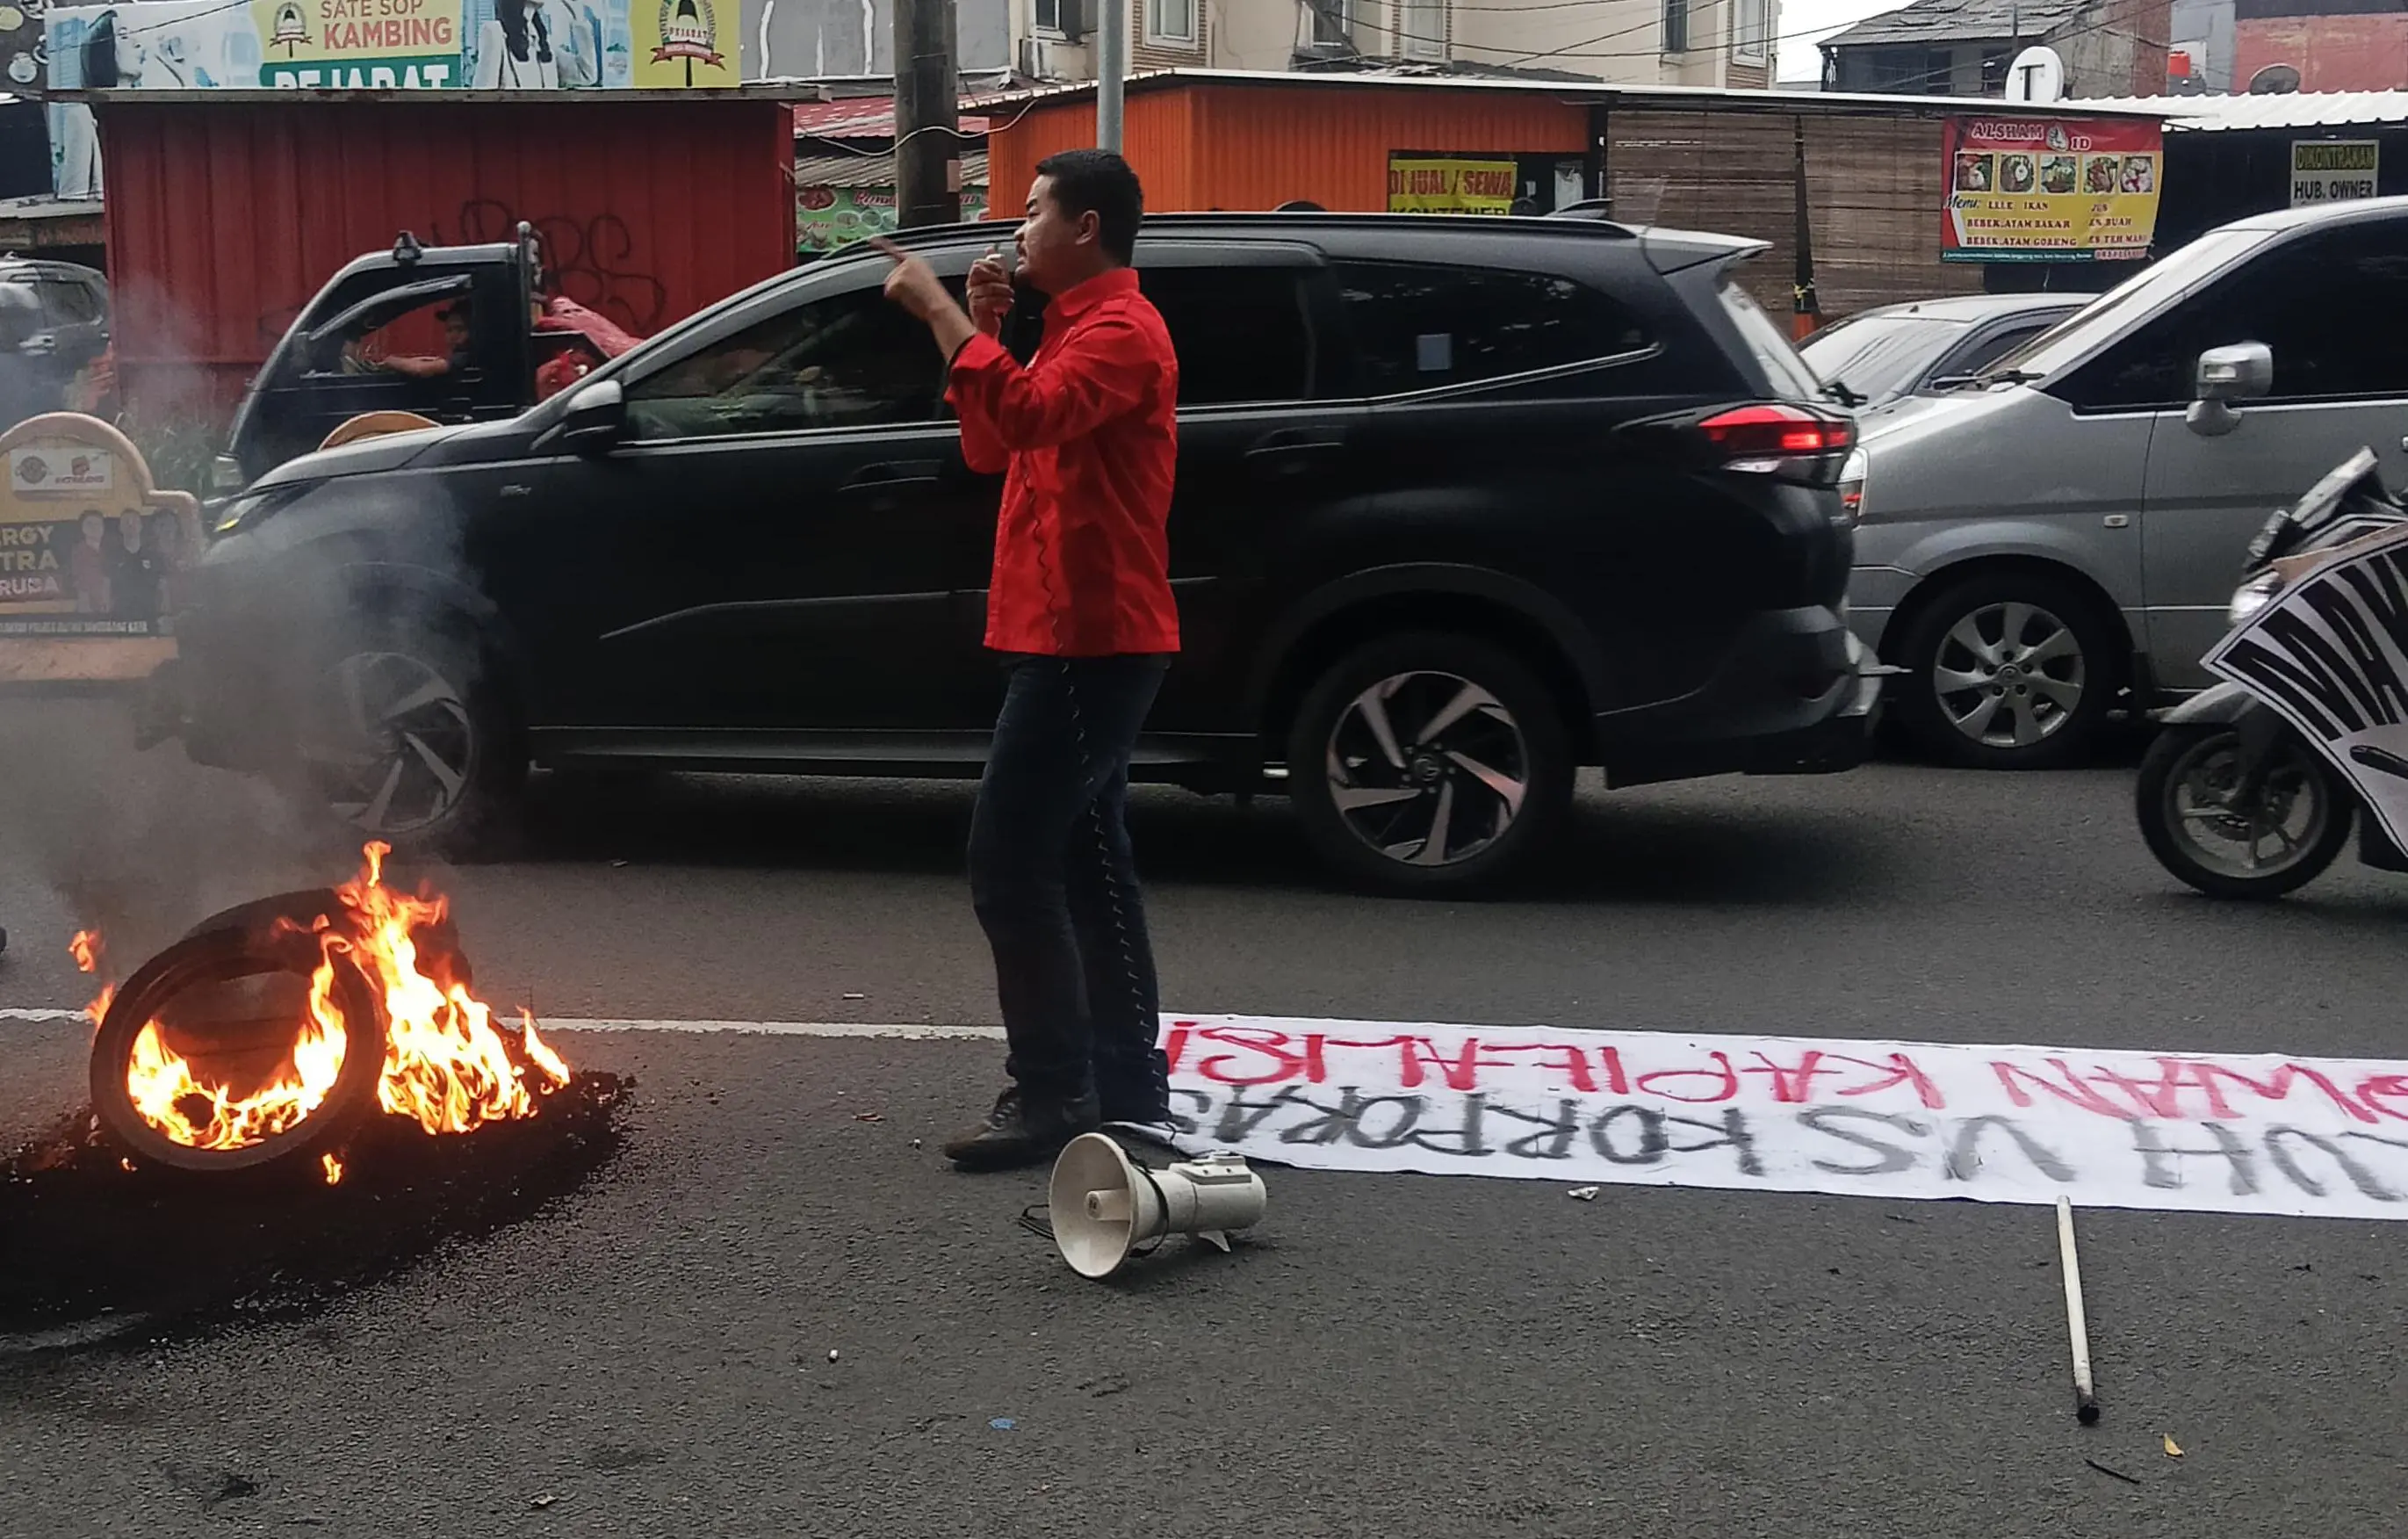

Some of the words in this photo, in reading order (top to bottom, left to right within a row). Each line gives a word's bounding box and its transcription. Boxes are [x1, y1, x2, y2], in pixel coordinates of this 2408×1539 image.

[321, 0, 372, 18] SATE
[379, 0, 423, 16] SOP
[324, 17, 452, 50] KAMBING
[2071, 136, 2092, 150] ID
[1464, 170, 1513, 197] SEWA
[2294, 180, 2325, 199] HUB.
[2330, 179, 2373, 199] OWNER
[2023, 201, 2049, 210] IKAN
[2035, 220, 2070, 228] BAKAR
[2105, 217, 2131, 226] BUAH
[2034, 237, 2077, 246] GORENG
[1797, 1108, 2076, 1181] VS
